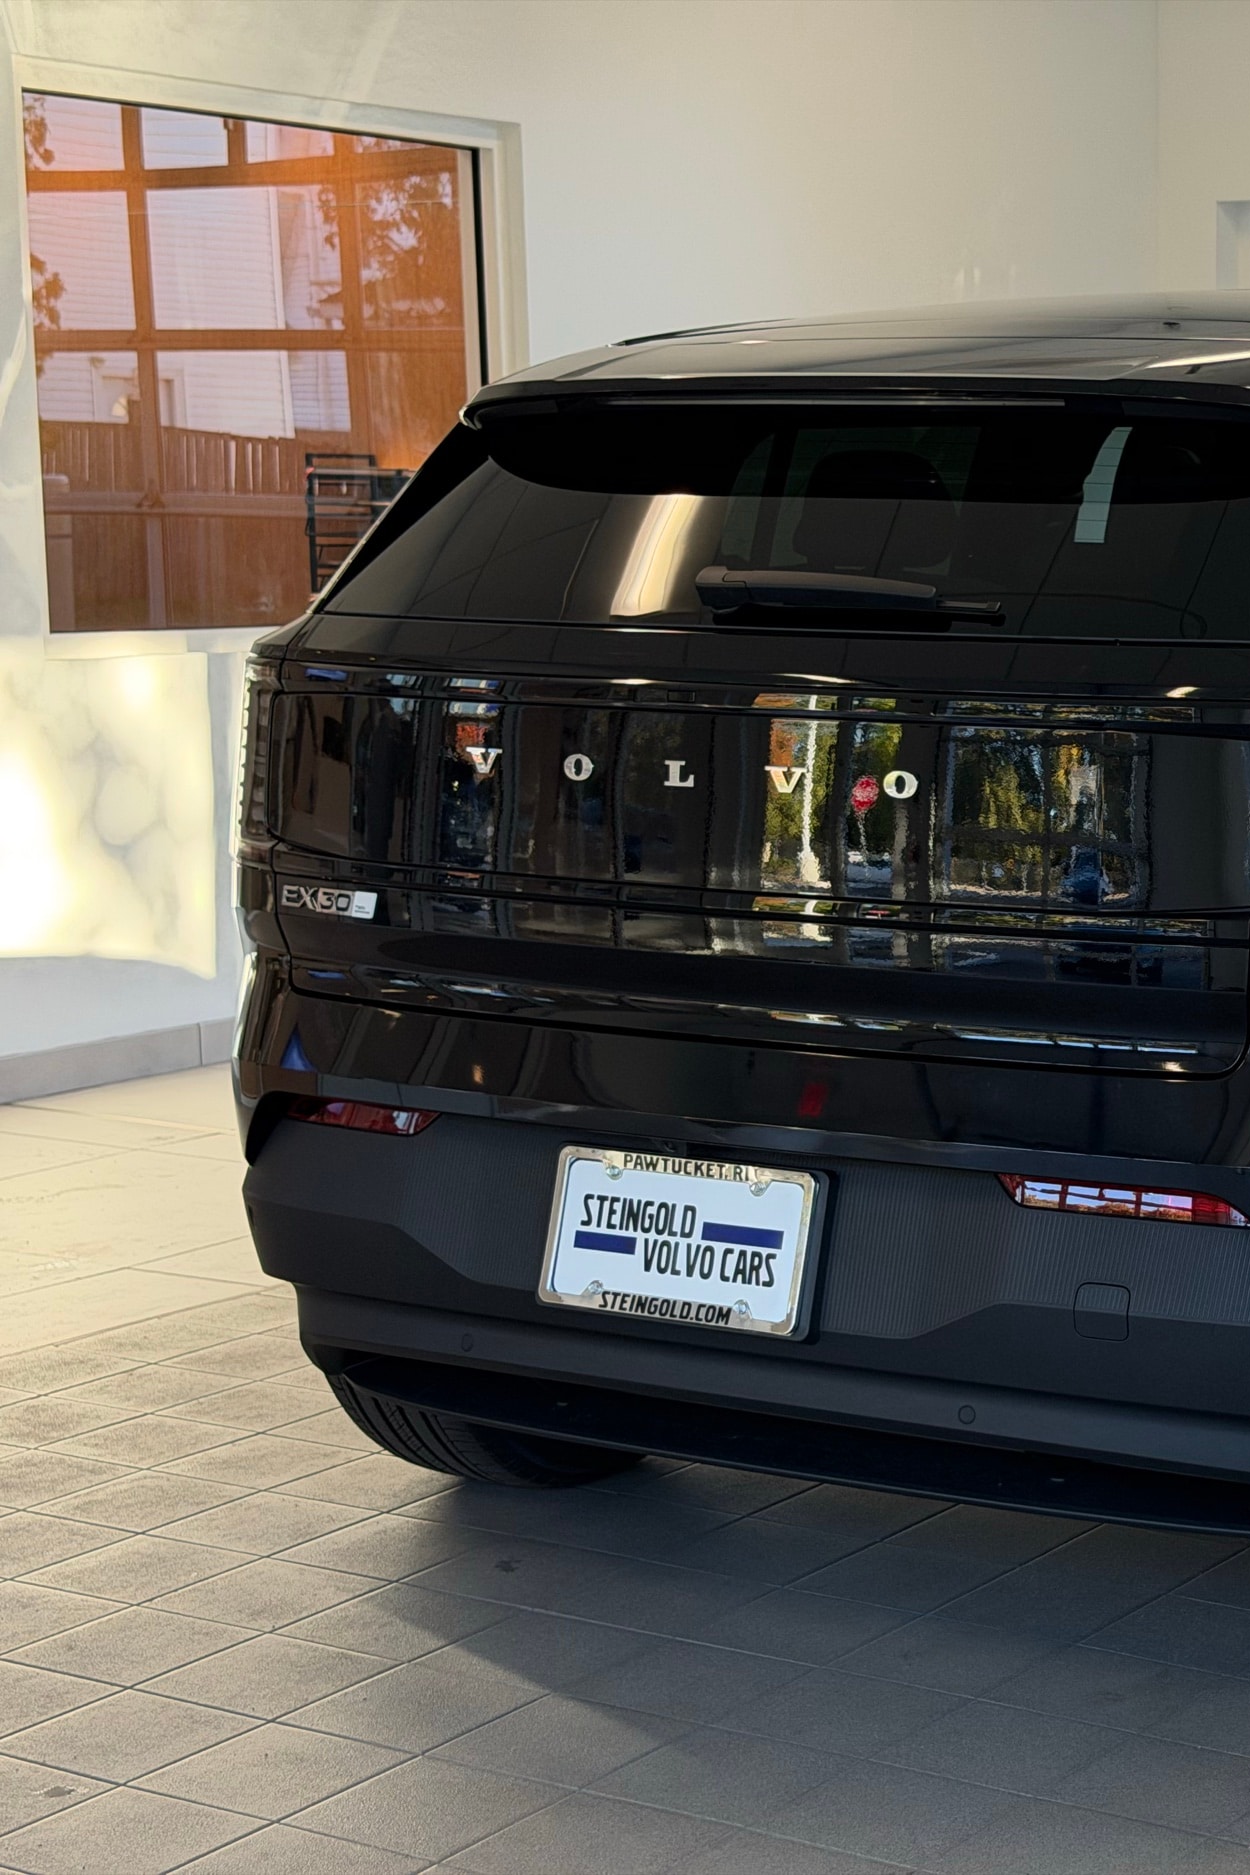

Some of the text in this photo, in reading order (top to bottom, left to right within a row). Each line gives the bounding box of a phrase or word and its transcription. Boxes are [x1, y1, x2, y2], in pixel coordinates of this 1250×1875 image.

[466, 746, 919, 799] VOLVO
[281, 884, 353, 917] EX30
[580, 1193, 697, 1239] STEINGOLD
[644, 1237, 777, 1288] VOLVO CARS
[598, 1291, 731, 1325] STEINGOLD.COM
